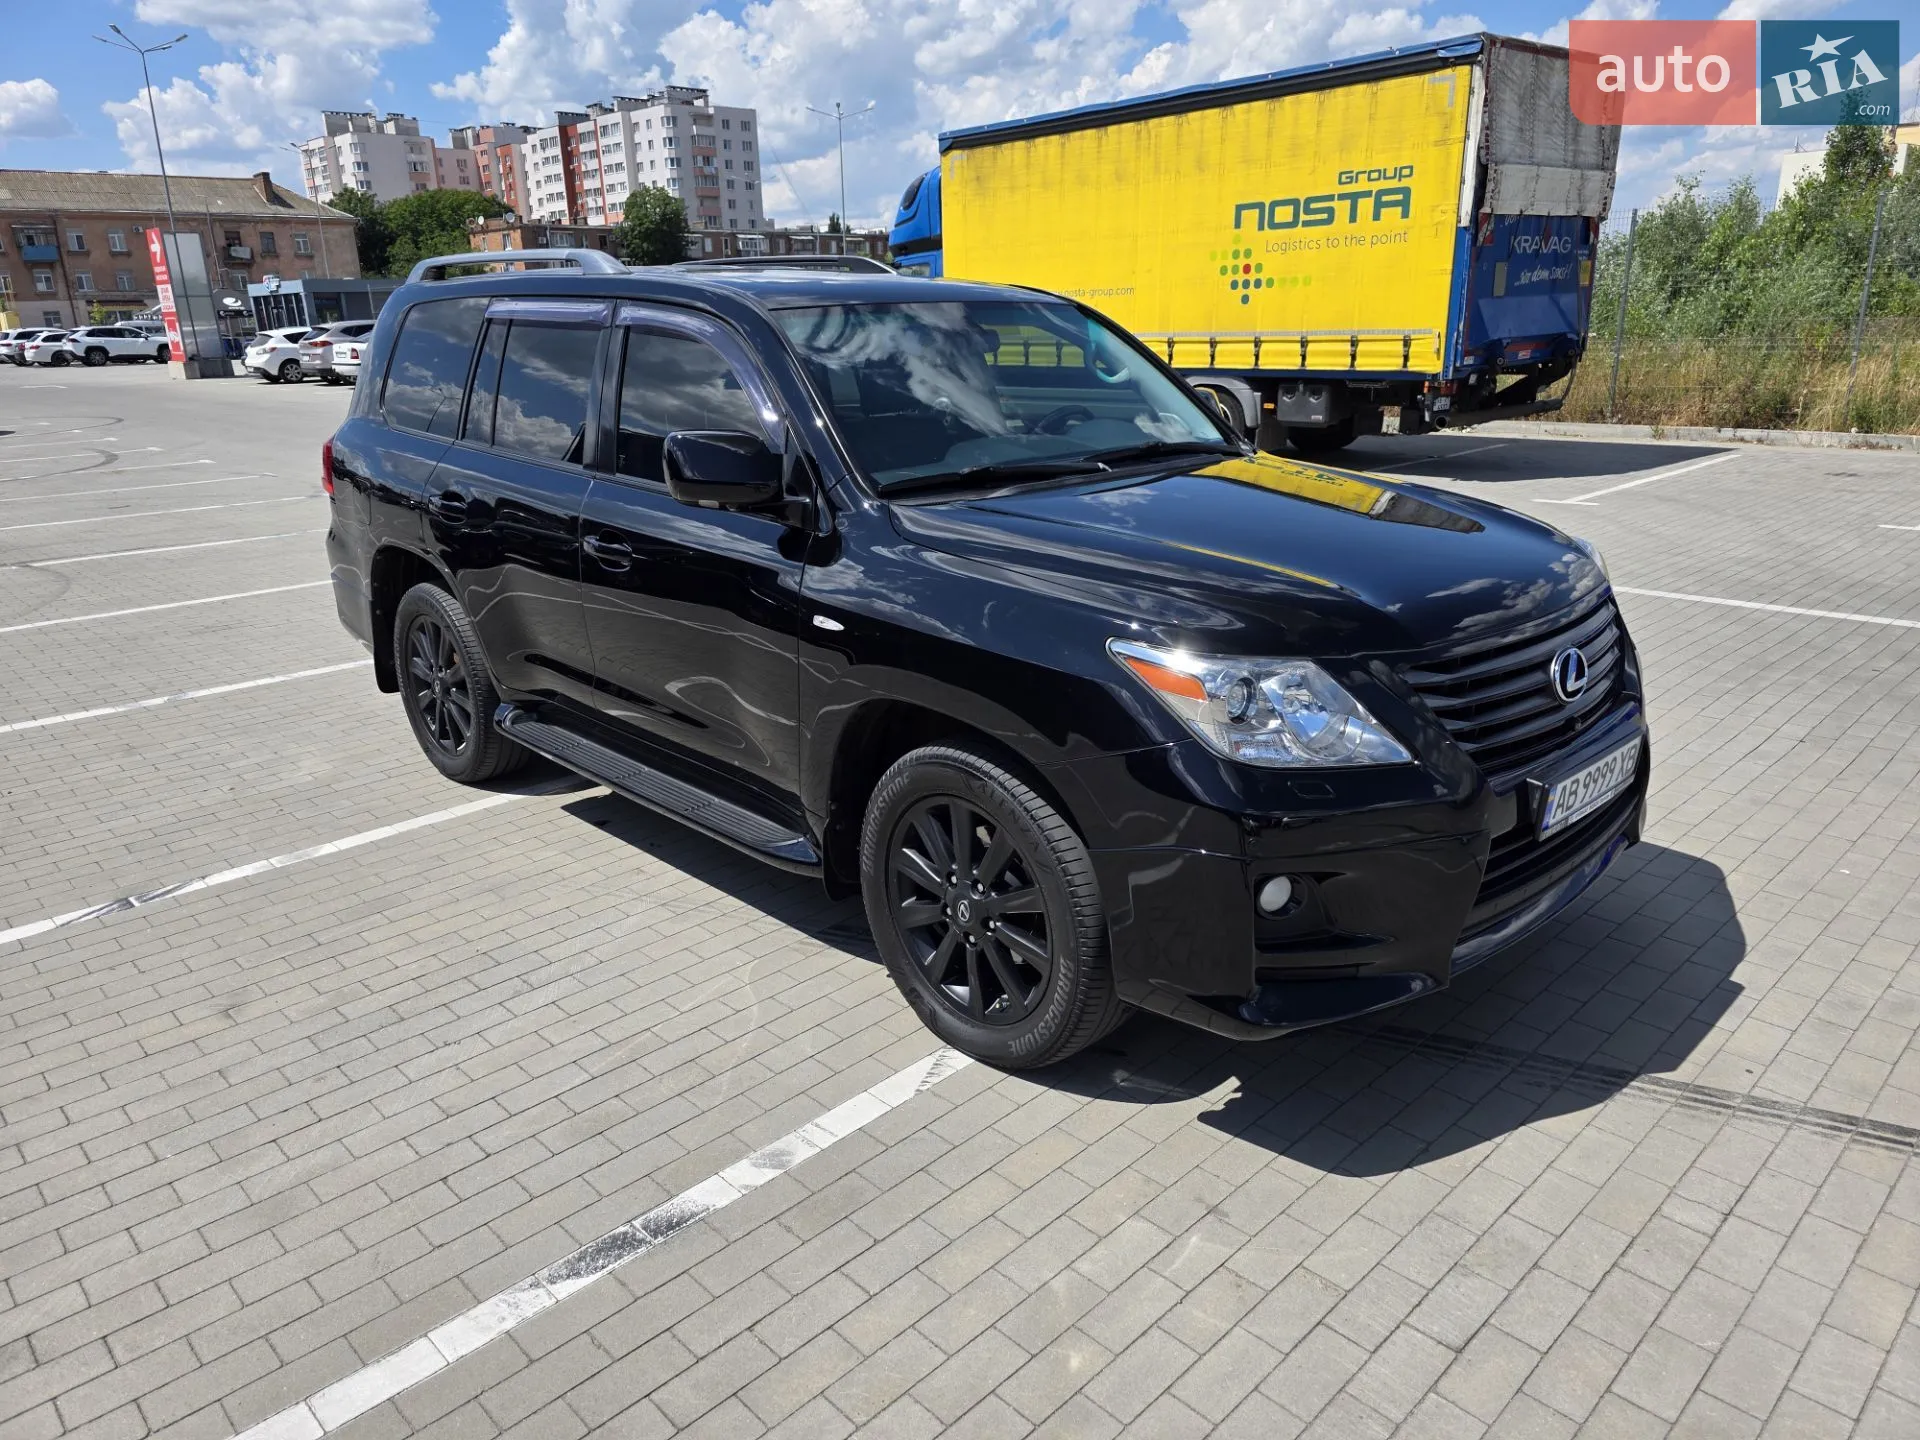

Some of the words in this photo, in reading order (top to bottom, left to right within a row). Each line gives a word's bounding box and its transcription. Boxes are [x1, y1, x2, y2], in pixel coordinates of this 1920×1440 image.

[1338, 165, 1413, 186] Group
[1265, 237, 1321, 255] Logistics
[1326, 236, 1340, 249] to
[1344, 233, 1366, 248] the
[1370, 229, 1409, 248] point
[1510, 235, 1572, 254] KRAVAG
[1552, 778, 1580, 819] AB
[1580, 756, 1617, 803] 9999
[1615, 743, 1638, 781] XB
[863, 772, 911, 877] BRIDGESTONE
[1008, 955, 1075, 1057] BRIDGESTONE
